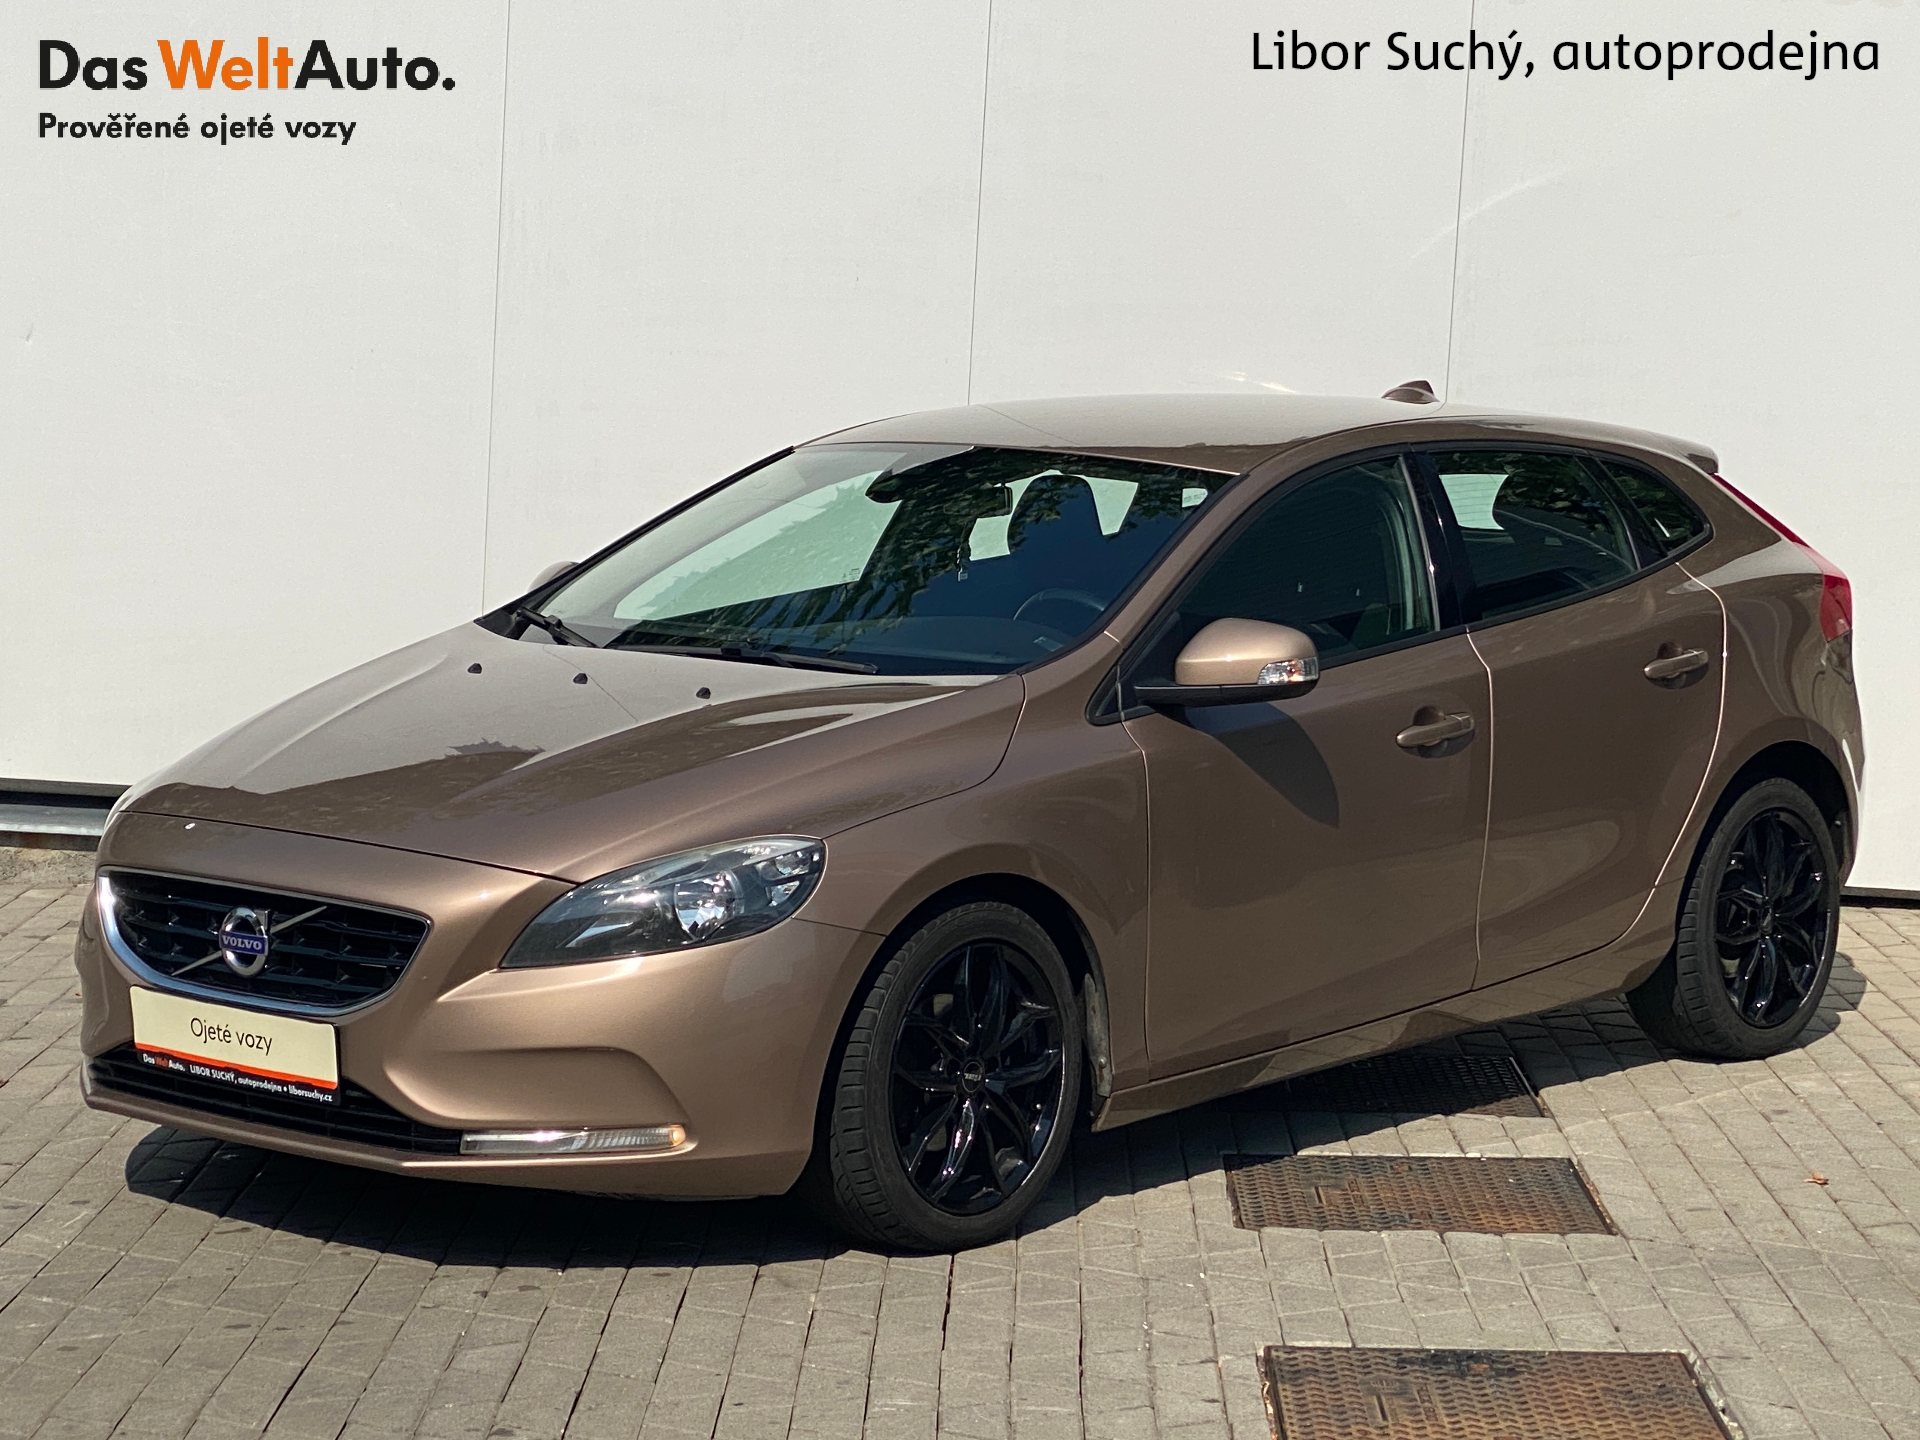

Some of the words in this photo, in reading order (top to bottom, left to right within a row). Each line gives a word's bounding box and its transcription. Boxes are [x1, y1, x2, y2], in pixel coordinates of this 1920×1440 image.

[222, 935, 263, 951] VOLVO
[190, 1017, 232, 1044] Ojeté
[235, 1031, 273, 1056] vozy
[142, 1053, 155, 1064] Das
[189, 1064, 211, 1077] LIBOR
[238, 1077, 282, 1092] autoprodejna
[288, 1085, 333, 1102] liborsuchy.cz
